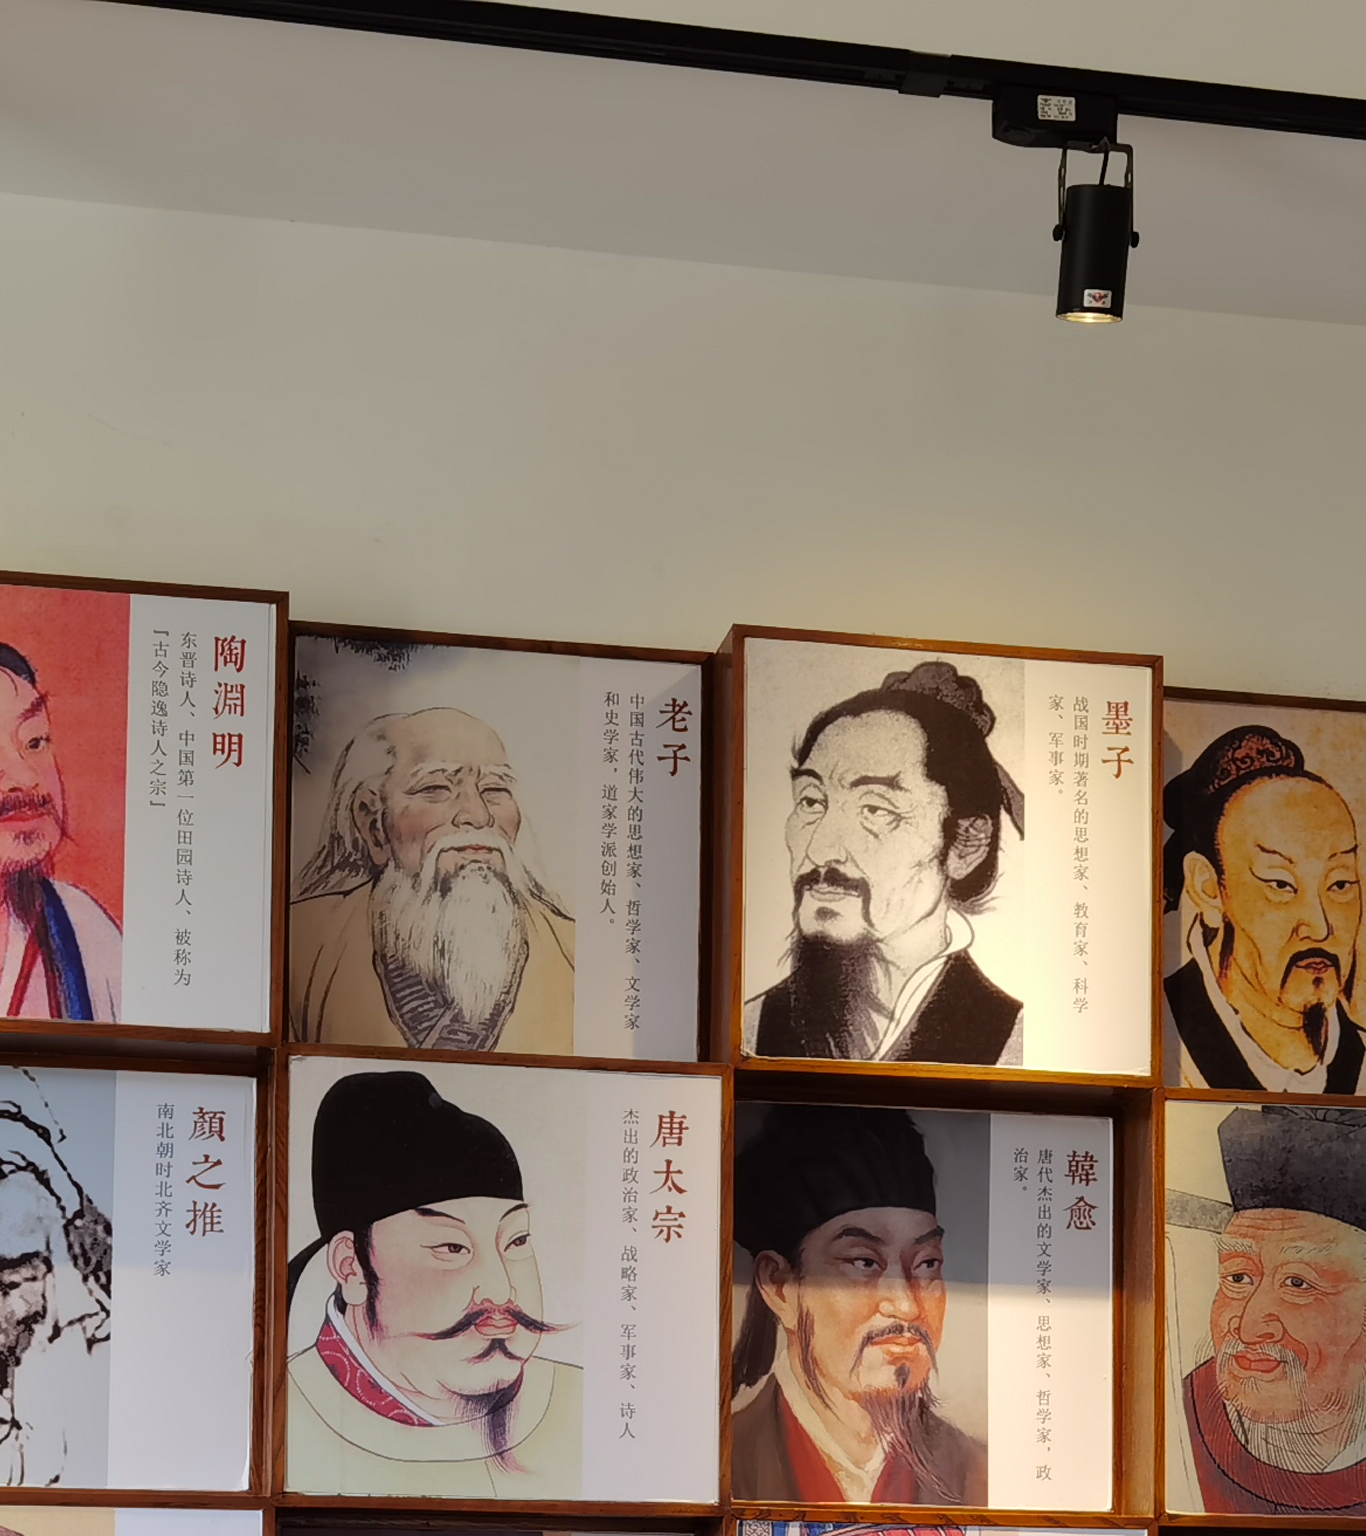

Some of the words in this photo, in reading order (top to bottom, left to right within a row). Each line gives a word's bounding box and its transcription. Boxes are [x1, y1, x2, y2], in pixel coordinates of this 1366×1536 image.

[212, 635, 247, 769] 陶淵明
[656, 698, 693, 776] 老子
[1101, 701, 1134, 780] 墨子
[153, 1103, 175, 1277] 南北朝时北齐文学家
[649, 1110, 689, 1243] 唐太宗
[1013, 1147, 1029, 1191] 治家。
[1062, 1150, 1099, 1231] 韓愈
